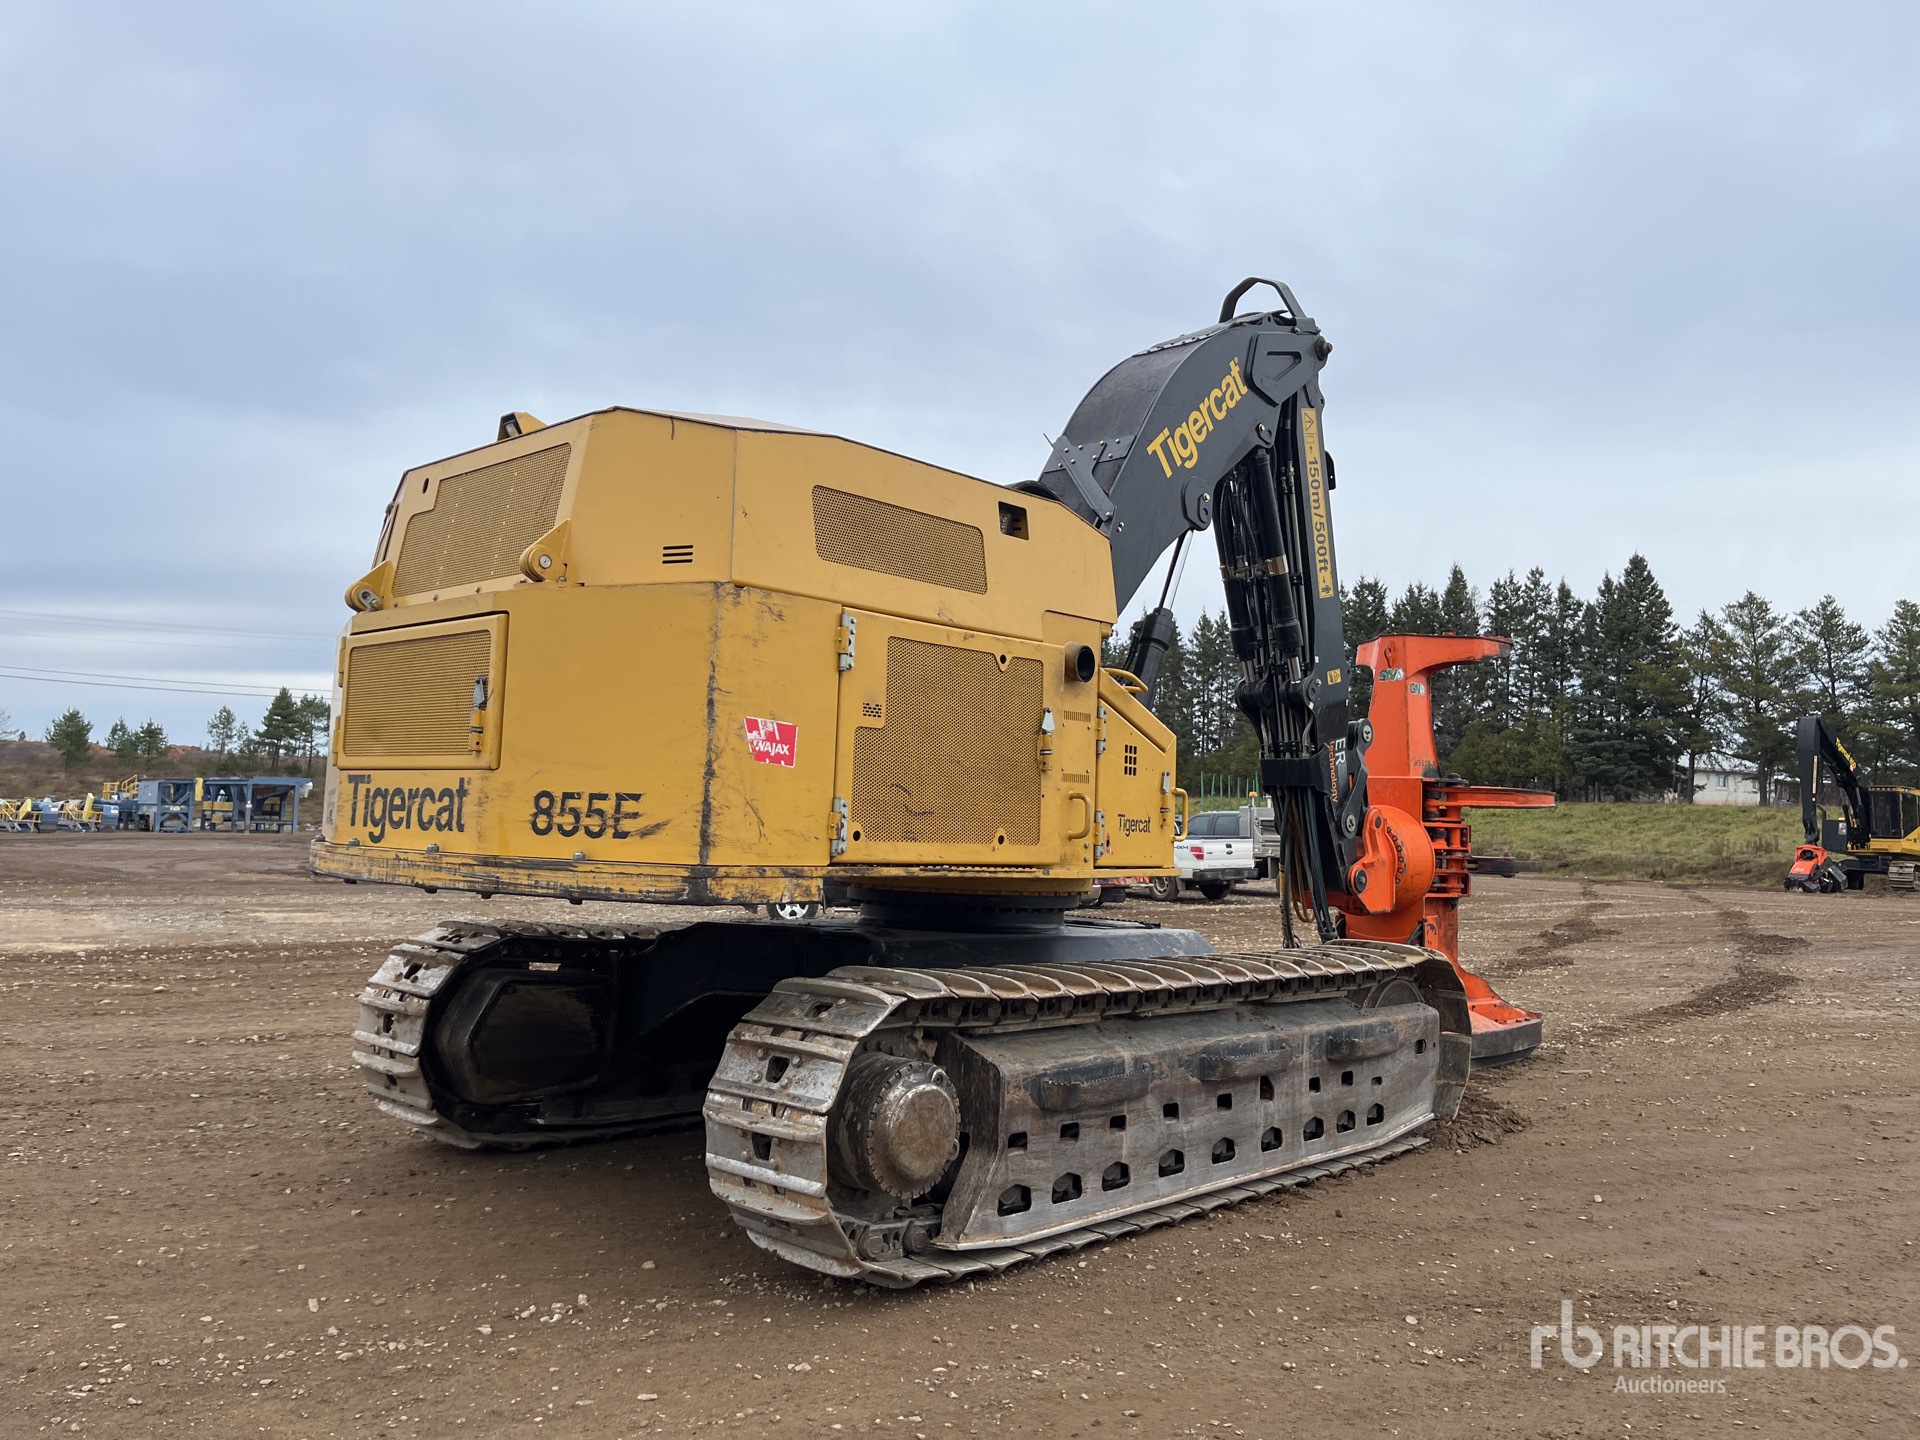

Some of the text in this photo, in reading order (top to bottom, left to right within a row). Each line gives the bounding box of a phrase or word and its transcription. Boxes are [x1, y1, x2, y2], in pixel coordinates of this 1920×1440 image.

[1146, 359, 1249, 479] Tigercat
[1309, 457, 1329, 573] 150m/500ft
[1329, 740, 1338, 803] technology
[1335, 738, 1346, 765] ER
[347, 774, 466, 843] Tigercat
[531, 790, 643, 839] 855E
[1117, 814, 1151, 837] Tigercat
